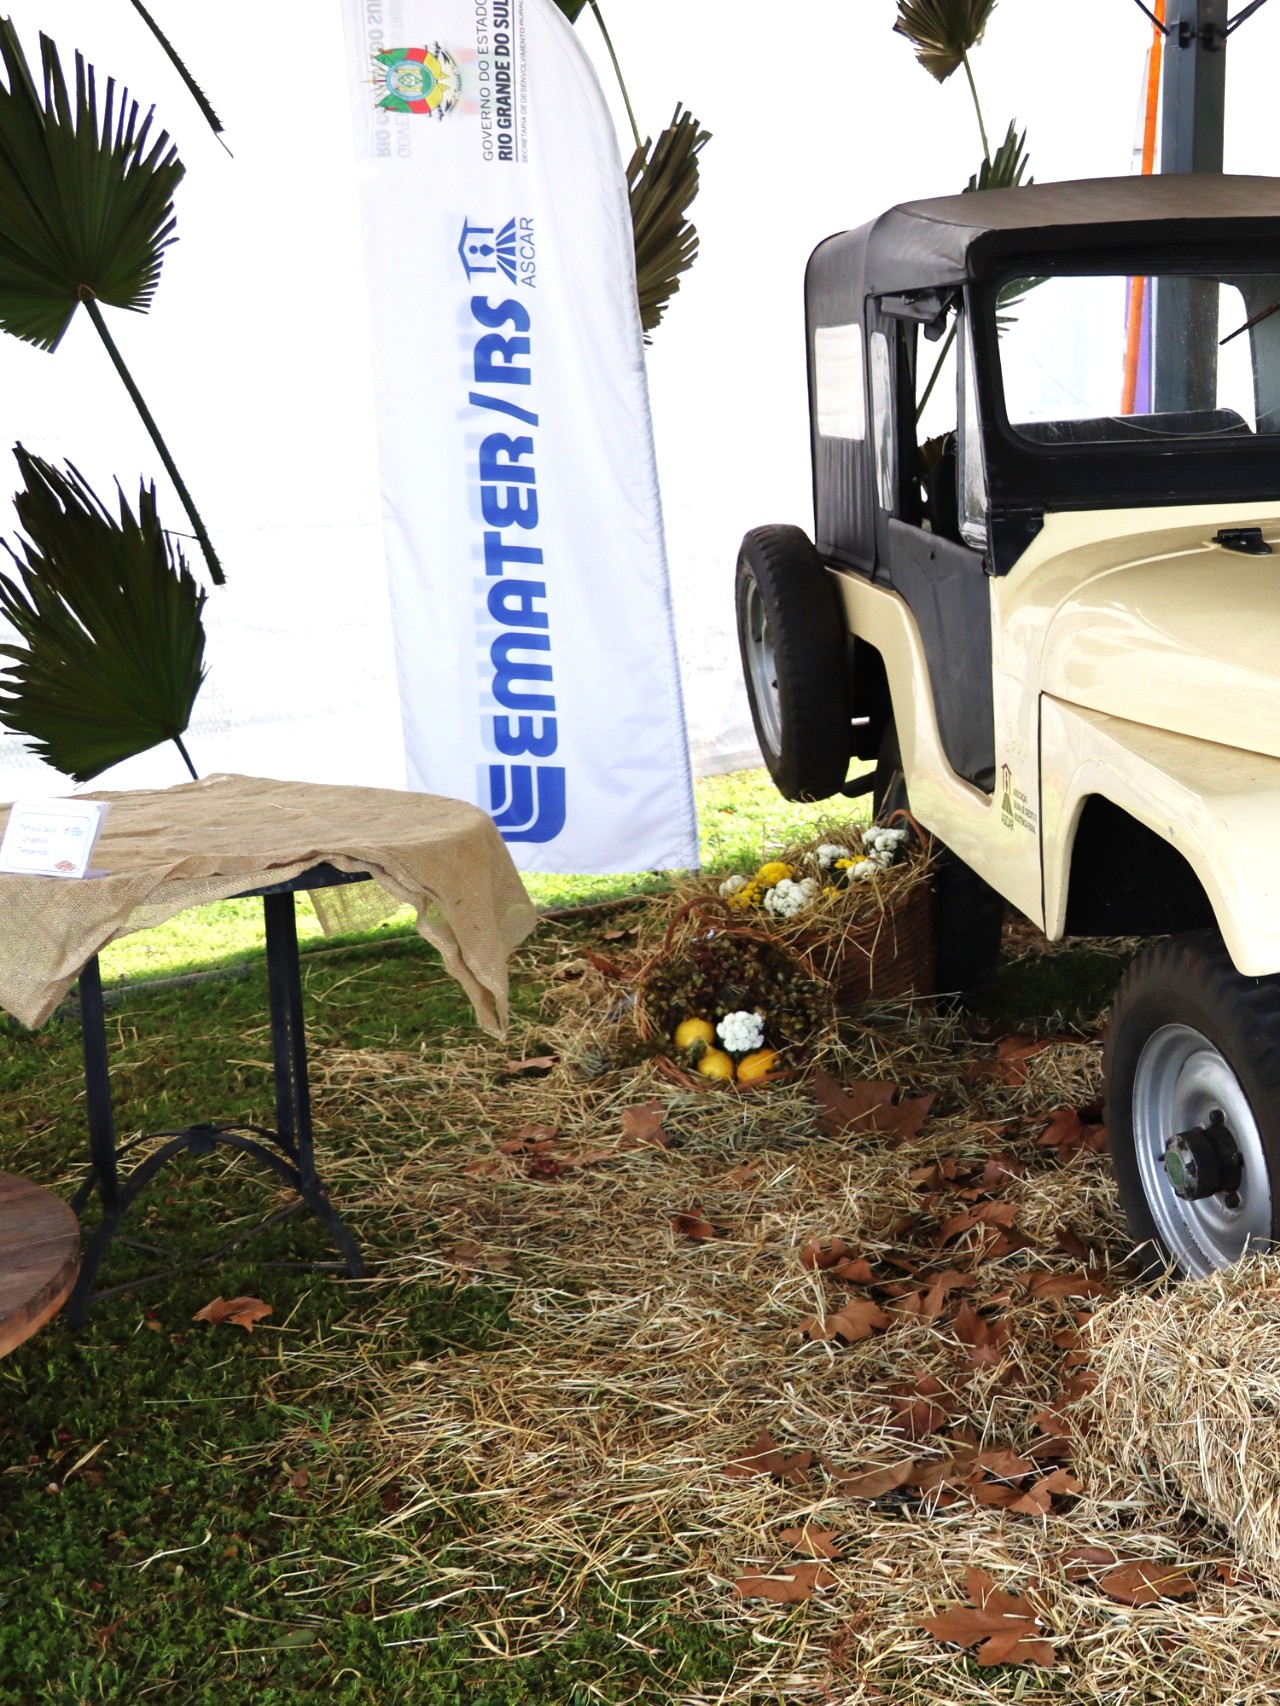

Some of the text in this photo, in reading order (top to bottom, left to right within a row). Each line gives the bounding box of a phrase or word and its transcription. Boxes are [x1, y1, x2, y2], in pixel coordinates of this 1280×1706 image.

[478, 60, 490, 82] DO
[493, 0, 513, 161] RIO GRANDE DO SUL
[519, 27, 528, 104] DESENVOLVIMENTO
[480, 87, 494, 161] GOVERNO
[520, 104, 527, 115] DE
[520, 116, 529, 163] SECRETARIA
[519, 217, 537, 288] ASCAR
[469, 296, 558, 757] EMATER/RS
